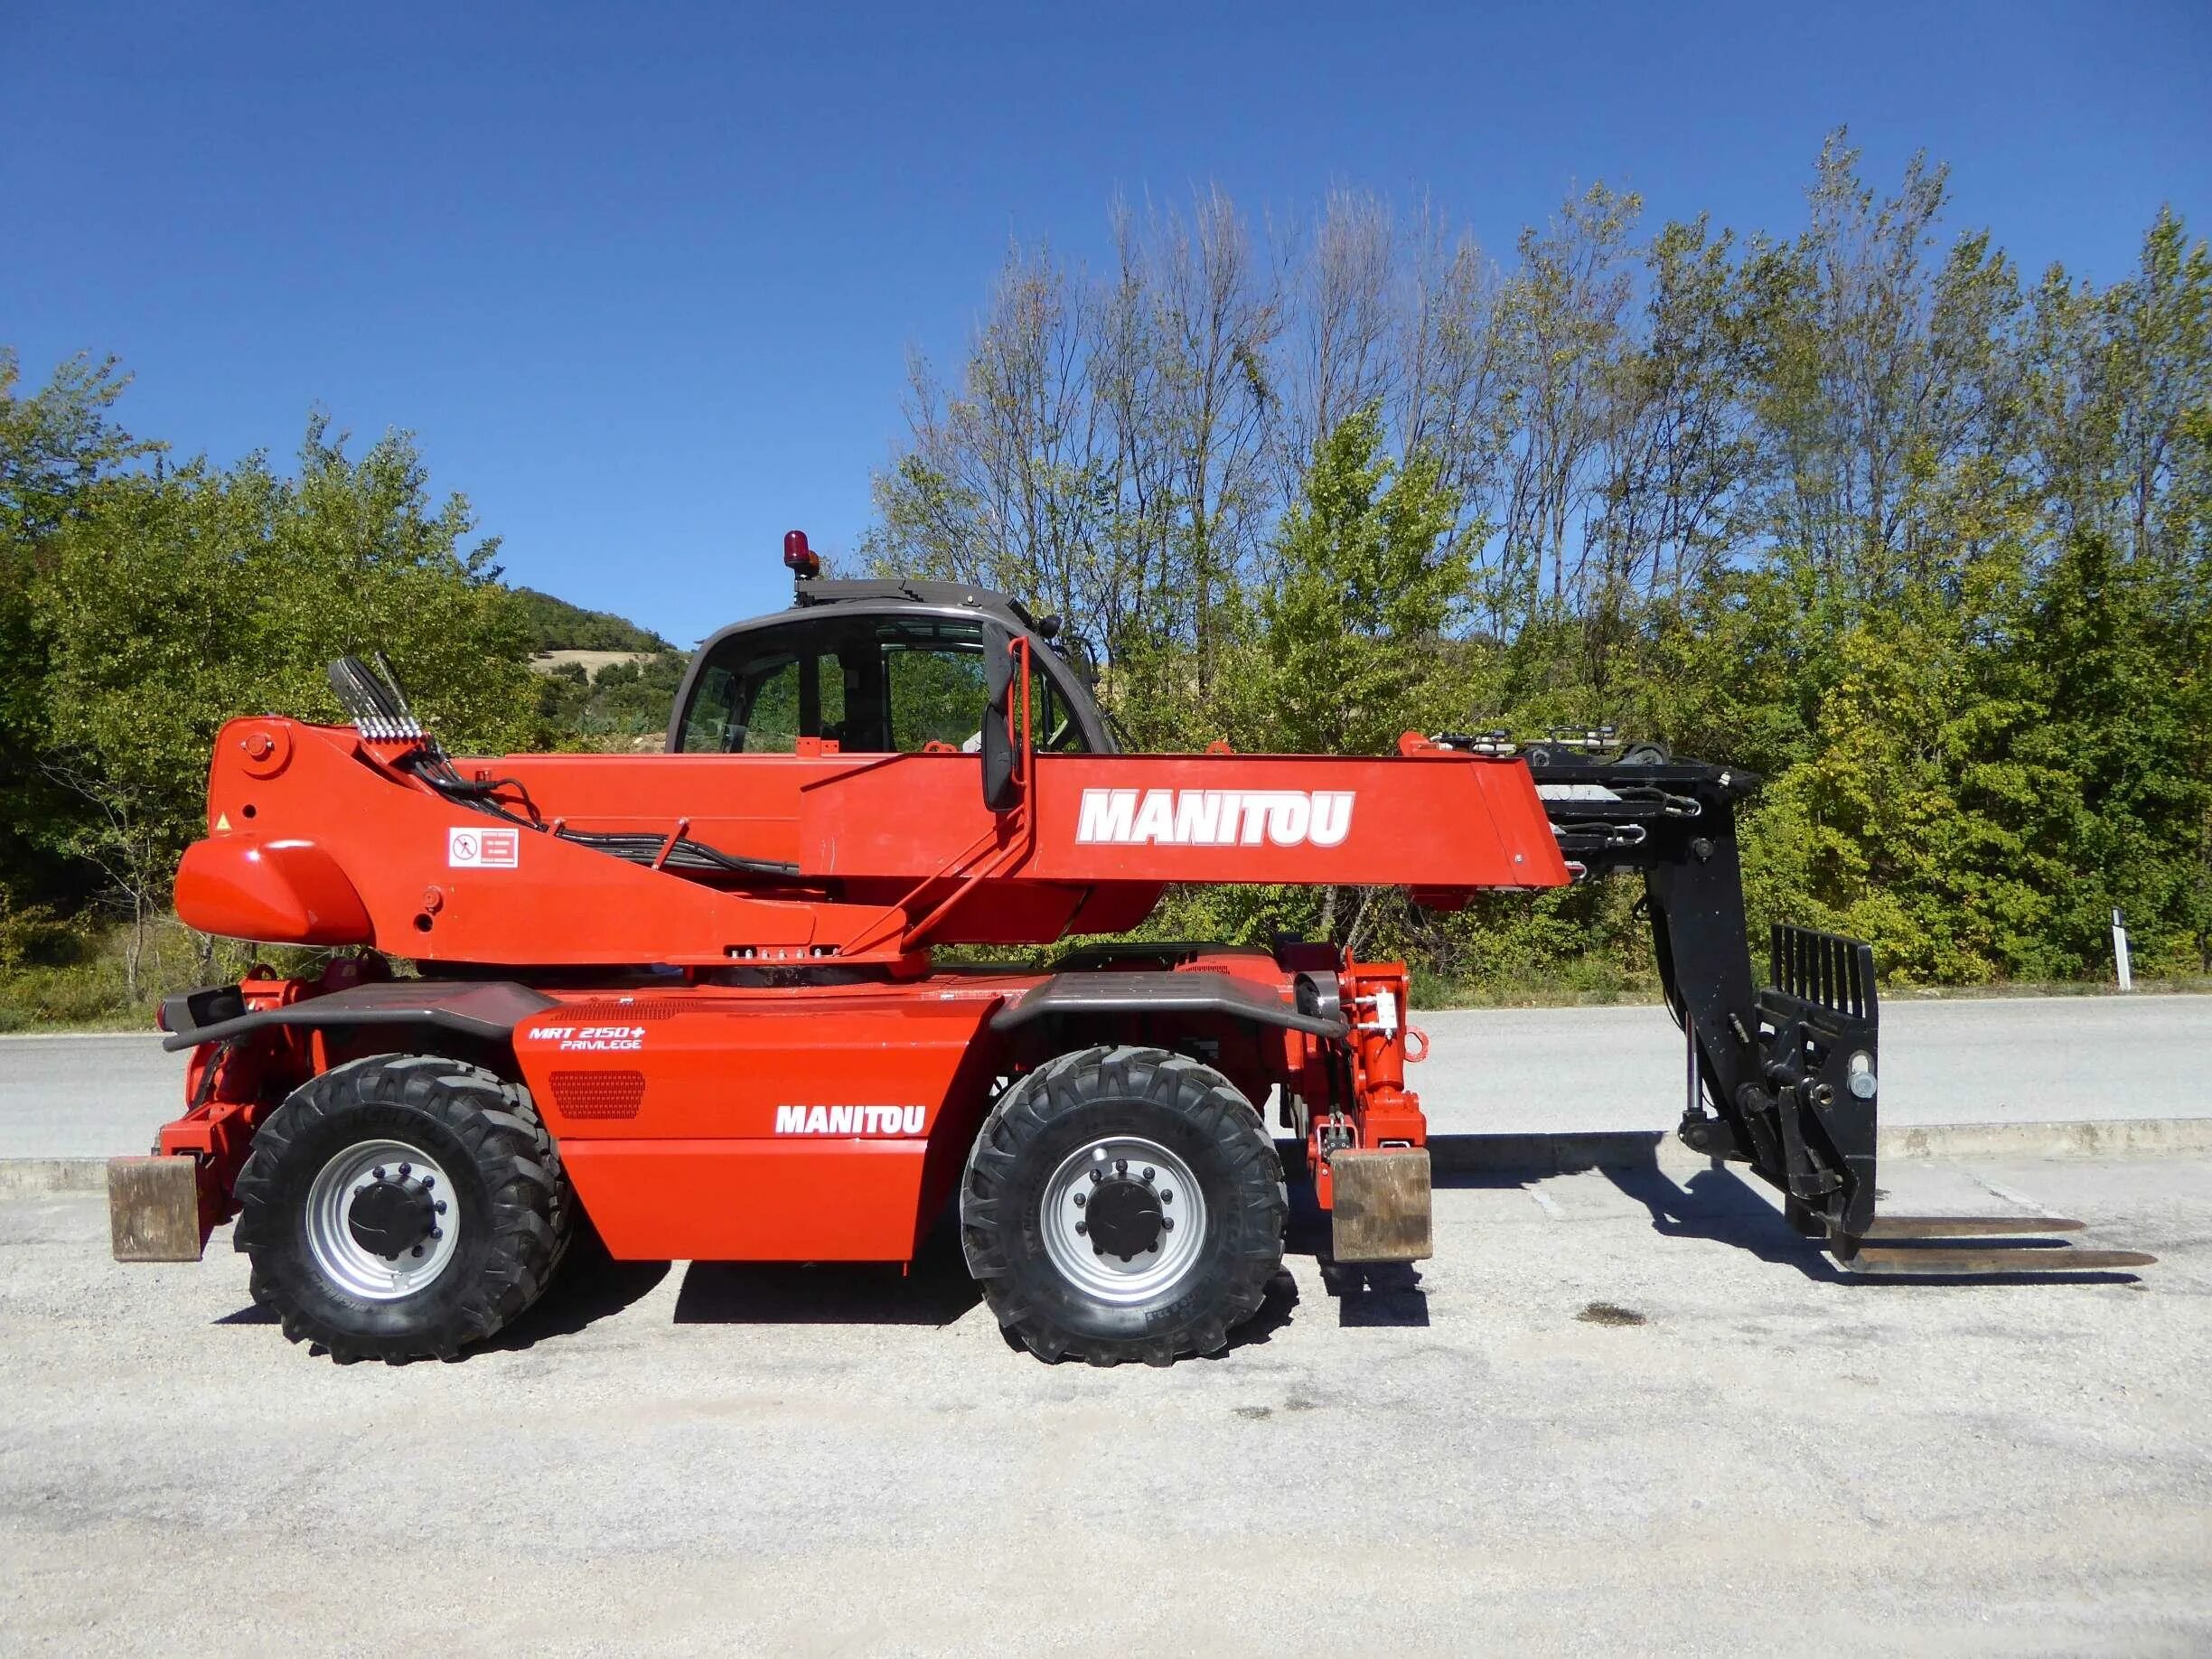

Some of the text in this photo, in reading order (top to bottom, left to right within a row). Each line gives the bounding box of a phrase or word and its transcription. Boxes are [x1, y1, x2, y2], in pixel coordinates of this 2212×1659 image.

[1075, 788, 1356, 848] MANITOU
[529, 1026, 646, 1039] MRT 2150+
[560, 1040, 642, 1050] PRIVILEGE
[775, 1105, 926, 1133] MANITOU
